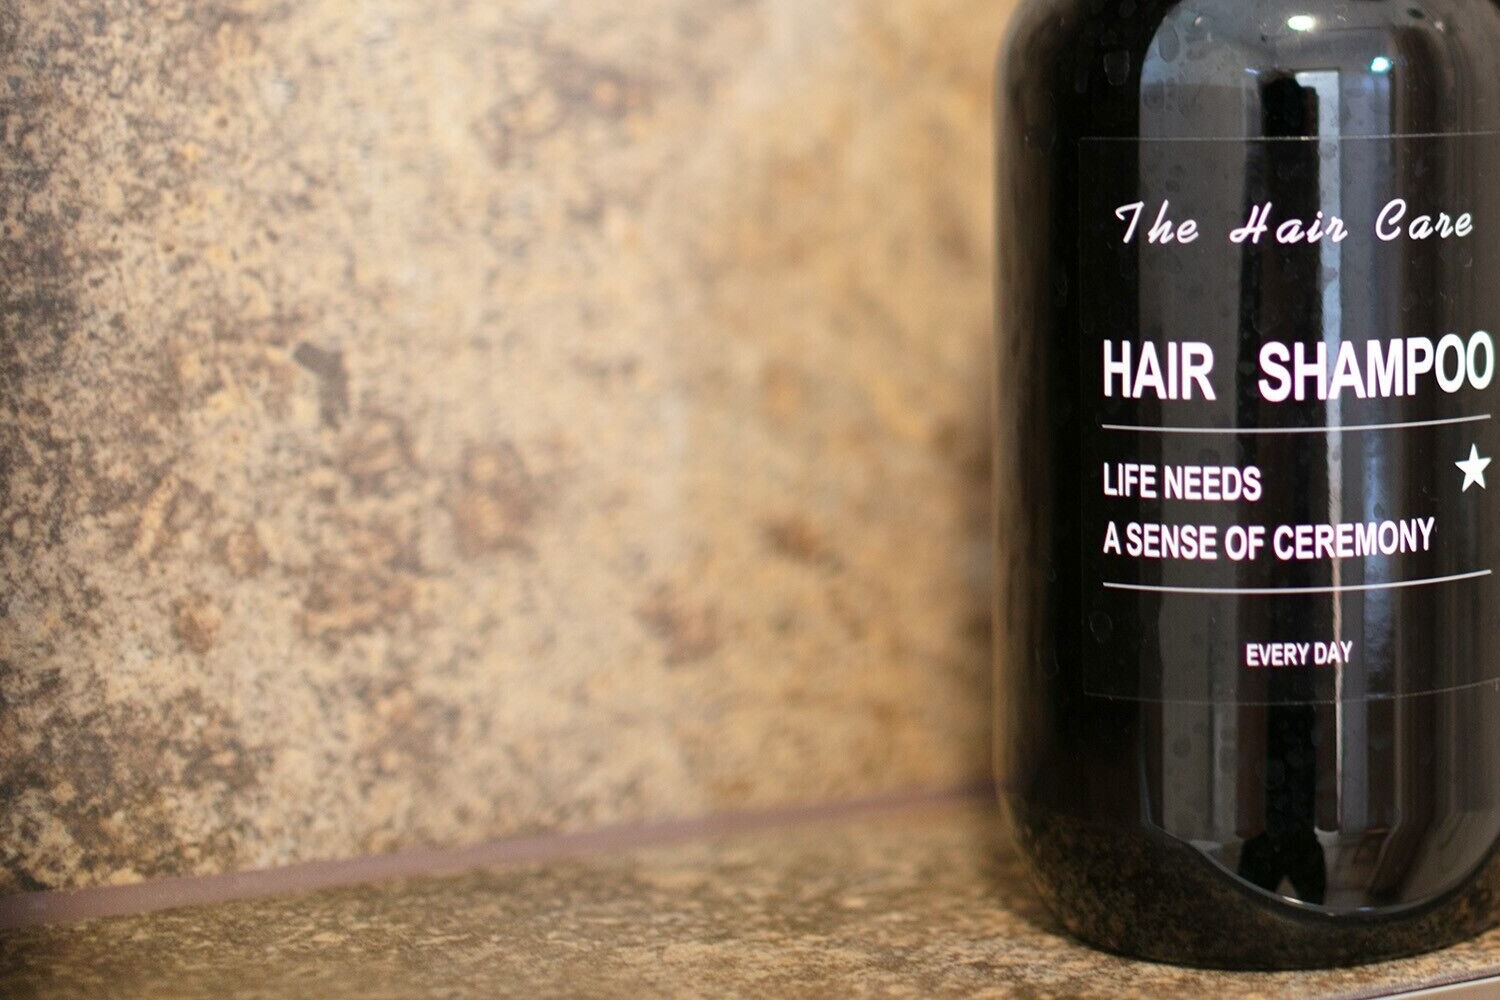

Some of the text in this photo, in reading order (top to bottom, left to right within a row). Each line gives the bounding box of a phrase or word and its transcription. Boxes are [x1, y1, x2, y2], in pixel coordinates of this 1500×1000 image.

[1114, 198, 1474, 245] The Hair Care
[1102, 330, 1495, 403] HAIR SHAMPOO
[1103, 462, 1263, 502] LIFE NEEDS
[1103, 516, 1436, 561] A SENSE OF CEREMONY
[1246, 640, 1353, 666] EVERY DAY
